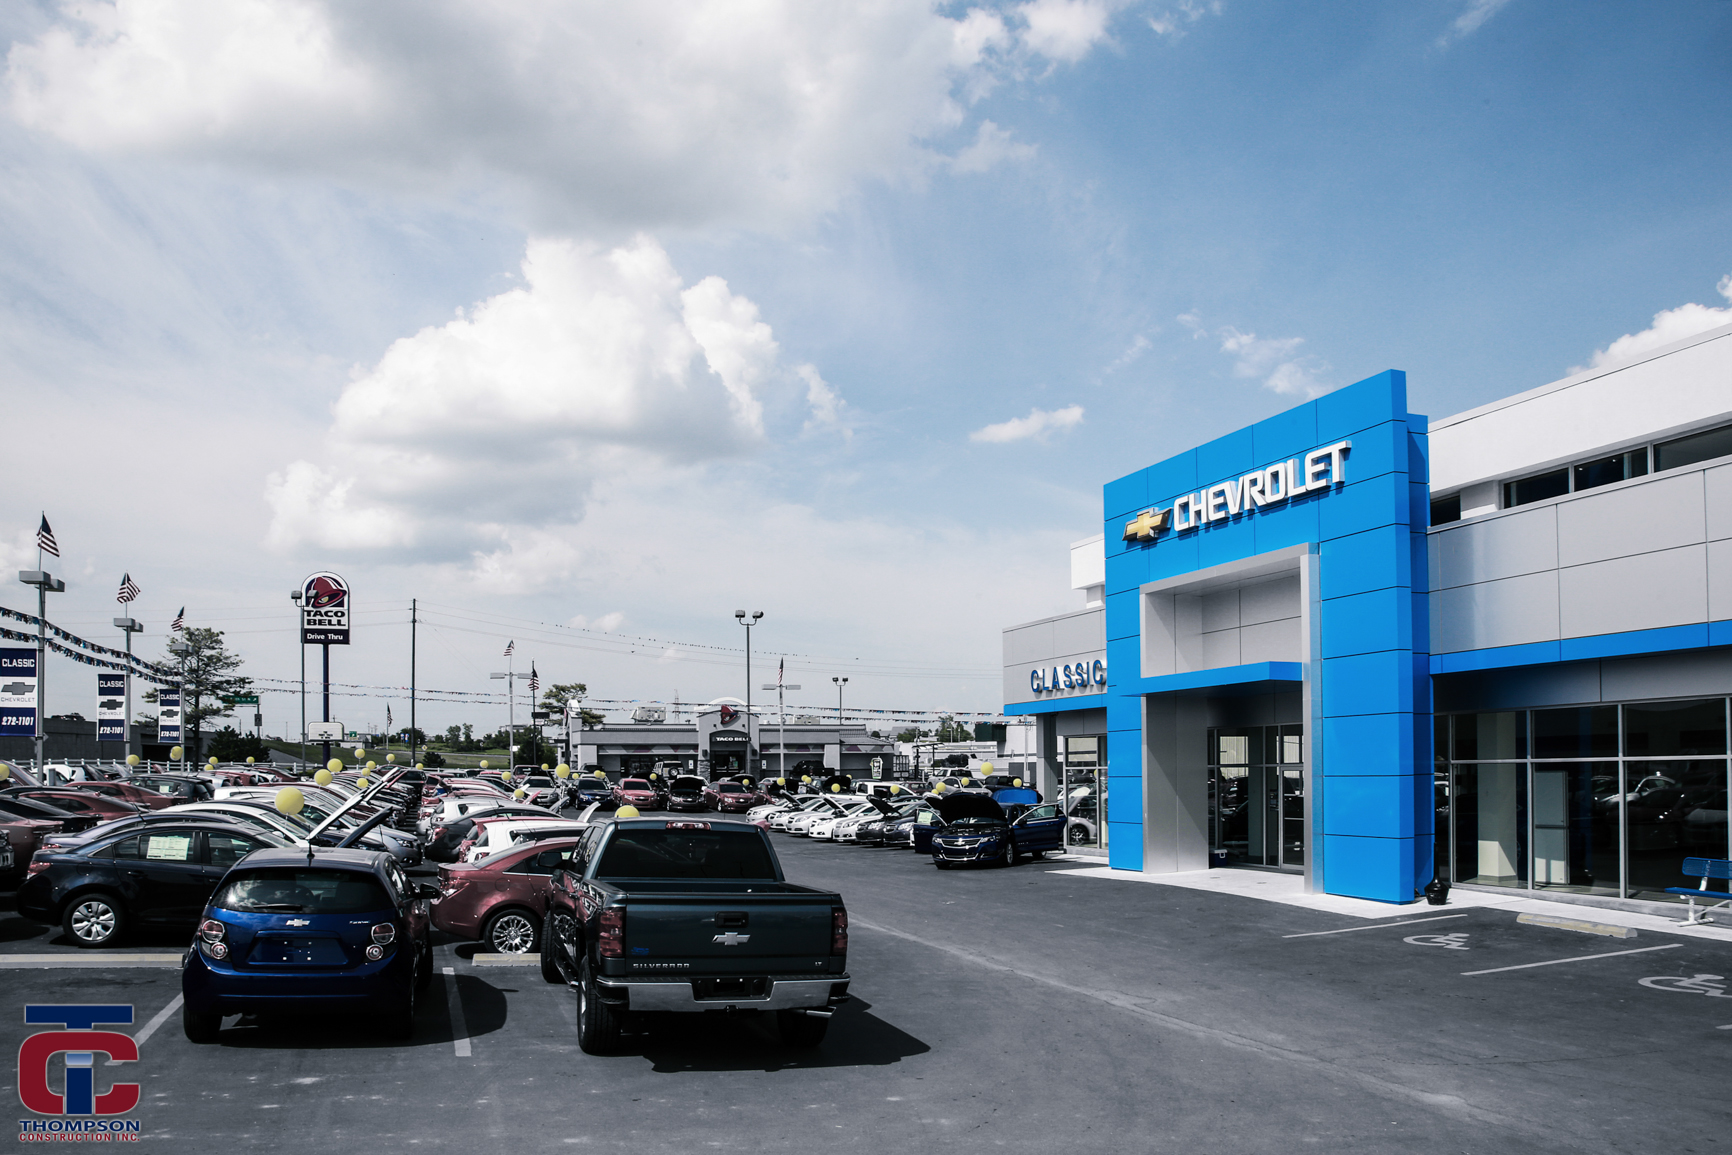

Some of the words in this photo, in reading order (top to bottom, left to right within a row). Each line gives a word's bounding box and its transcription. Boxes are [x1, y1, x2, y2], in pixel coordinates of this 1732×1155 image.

[1173, 440, 1352, 532] CHEVROLET
[303, 610, 346, 618] TACO
[306, 619, 346, 627] BELL
[1, 658, 35, 668] CLASSIC
[1030, 659, 1104, 693] CLASSIC
[99, 680, 125, 688] CLASSIC
[1, 716, 34, 726] 272-1101
